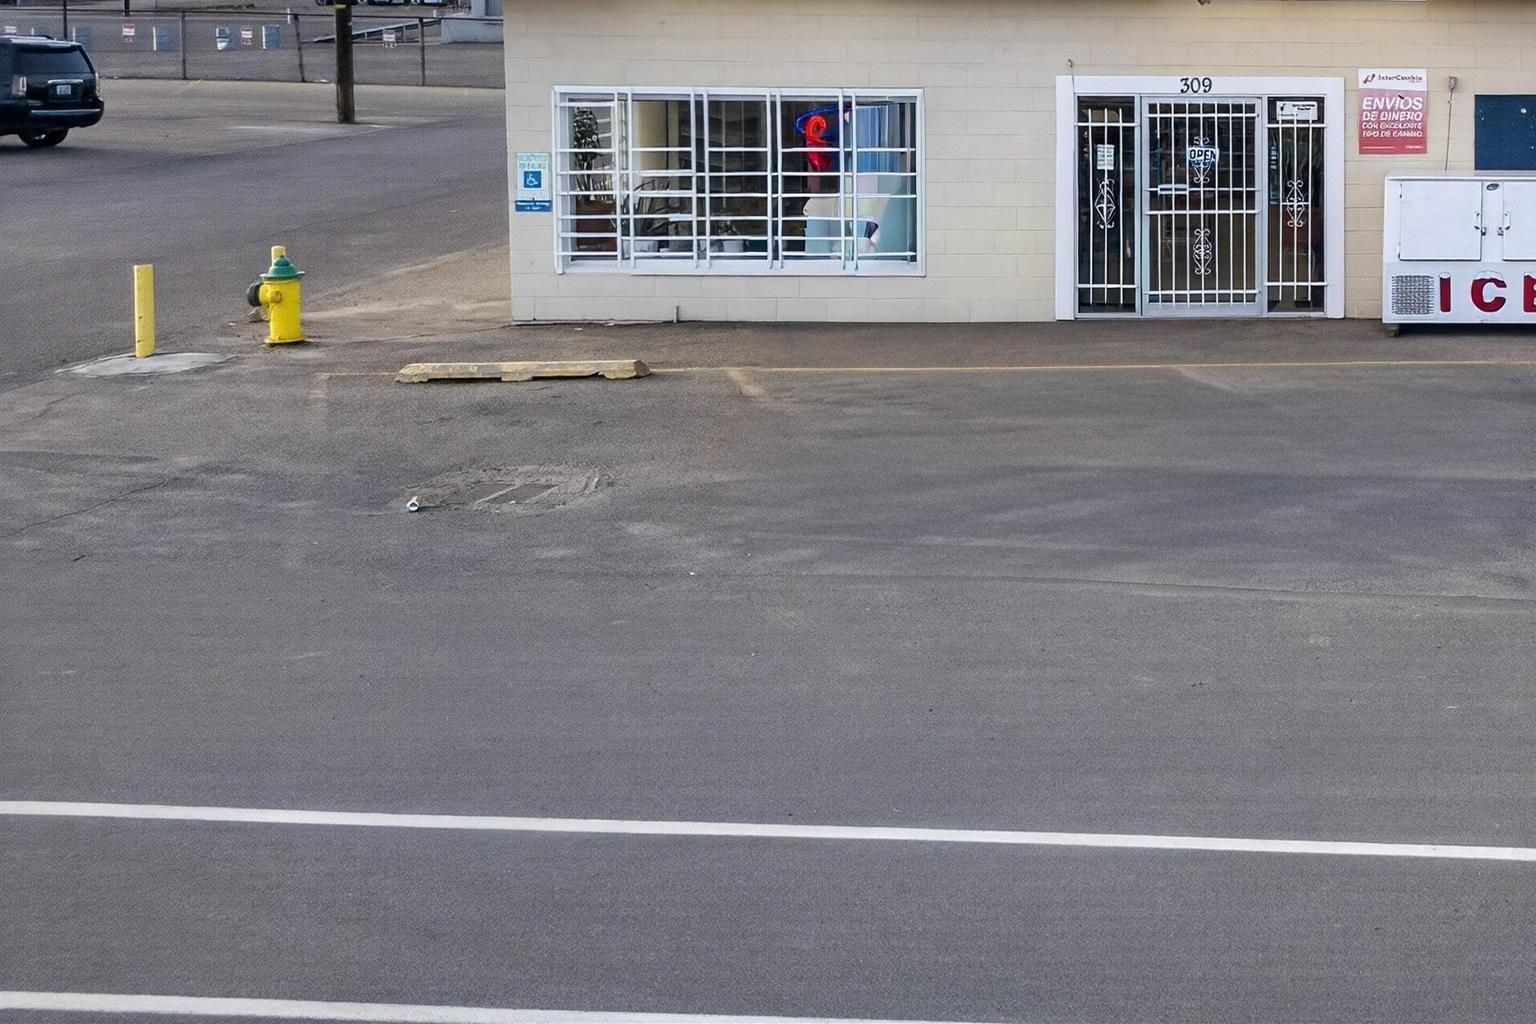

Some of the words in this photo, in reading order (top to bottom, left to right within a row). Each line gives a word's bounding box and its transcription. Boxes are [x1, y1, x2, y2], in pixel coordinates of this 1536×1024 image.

[1180, 77, 1213, 94] 309
[1363, 111, 1379, 121] DE
[1380, 111, 1423, 121] DINERO
[1190, 149, 1216, 162] OPEN
